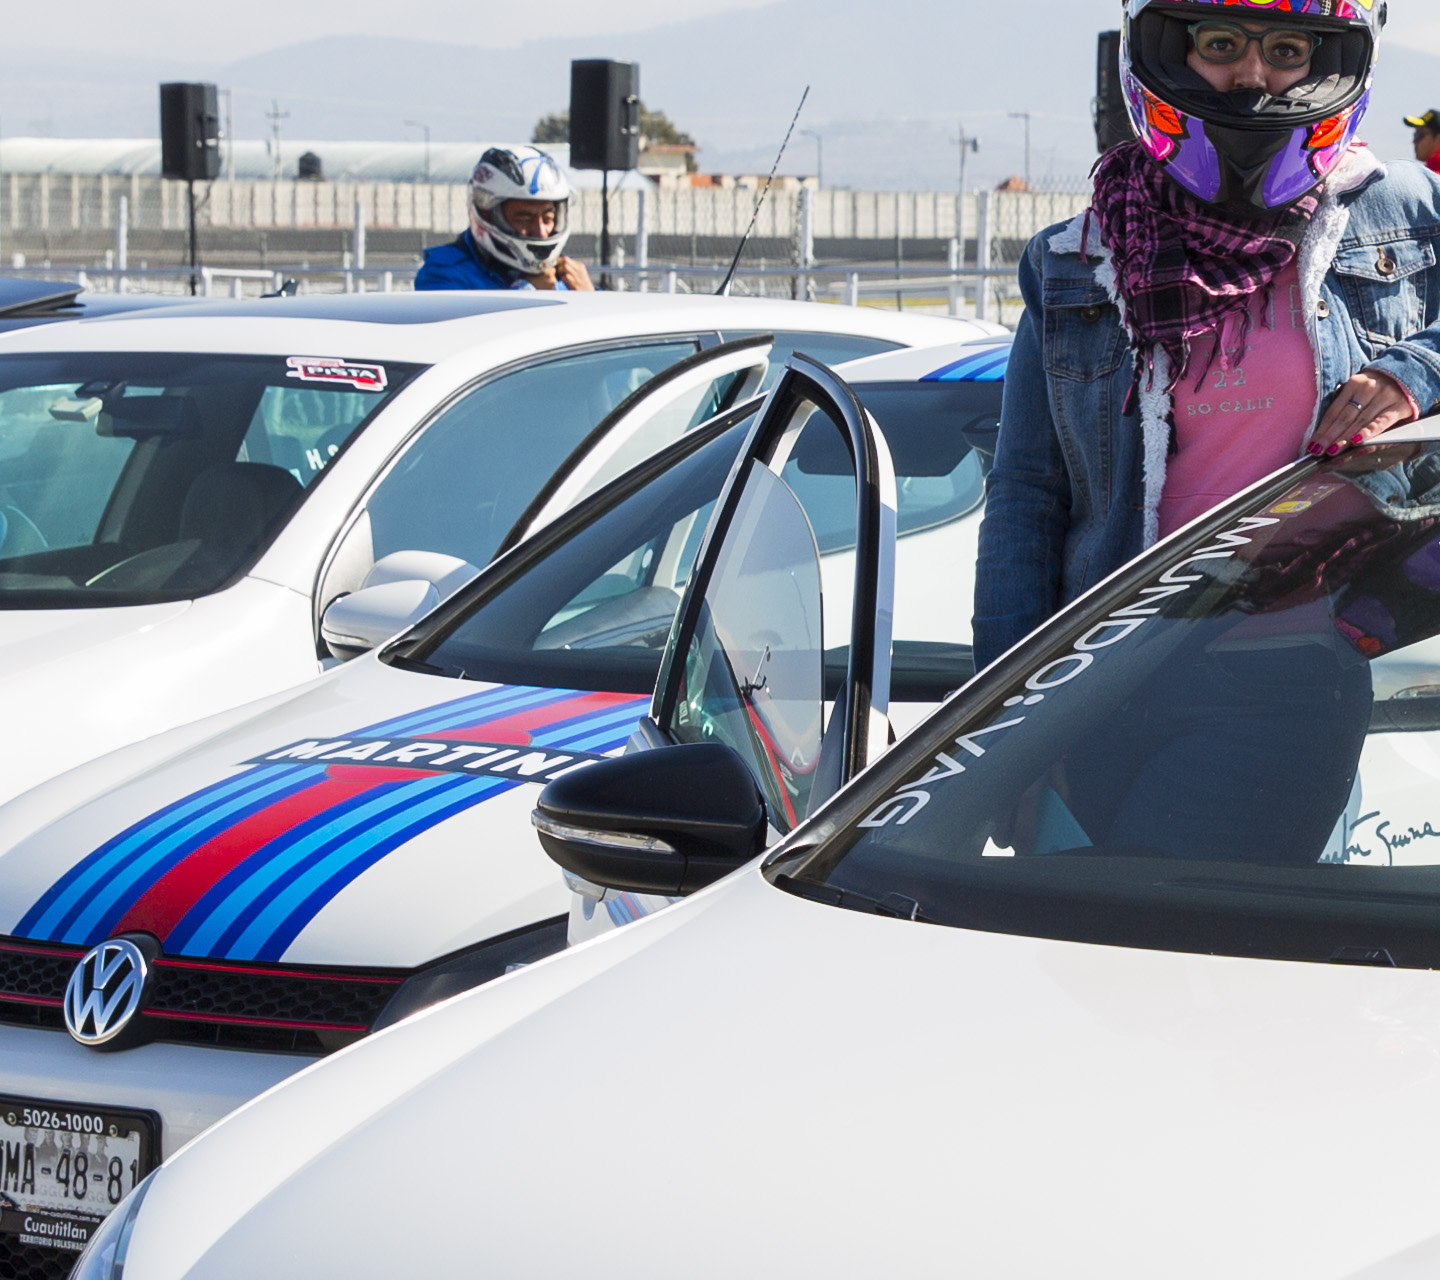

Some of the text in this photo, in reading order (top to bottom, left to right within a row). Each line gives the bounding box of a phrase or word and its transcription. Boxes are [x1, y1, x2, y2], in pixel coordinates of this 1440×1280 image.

[1212, 368, 1247, 388] 22
[64, 939, 147, 1045] VW
[23, 1108, 104, 1134] 5026-1000
[19, 1233, 53, 1247] TERRITORIO
[24, 1216, 87, 1240] Cuautitlán
